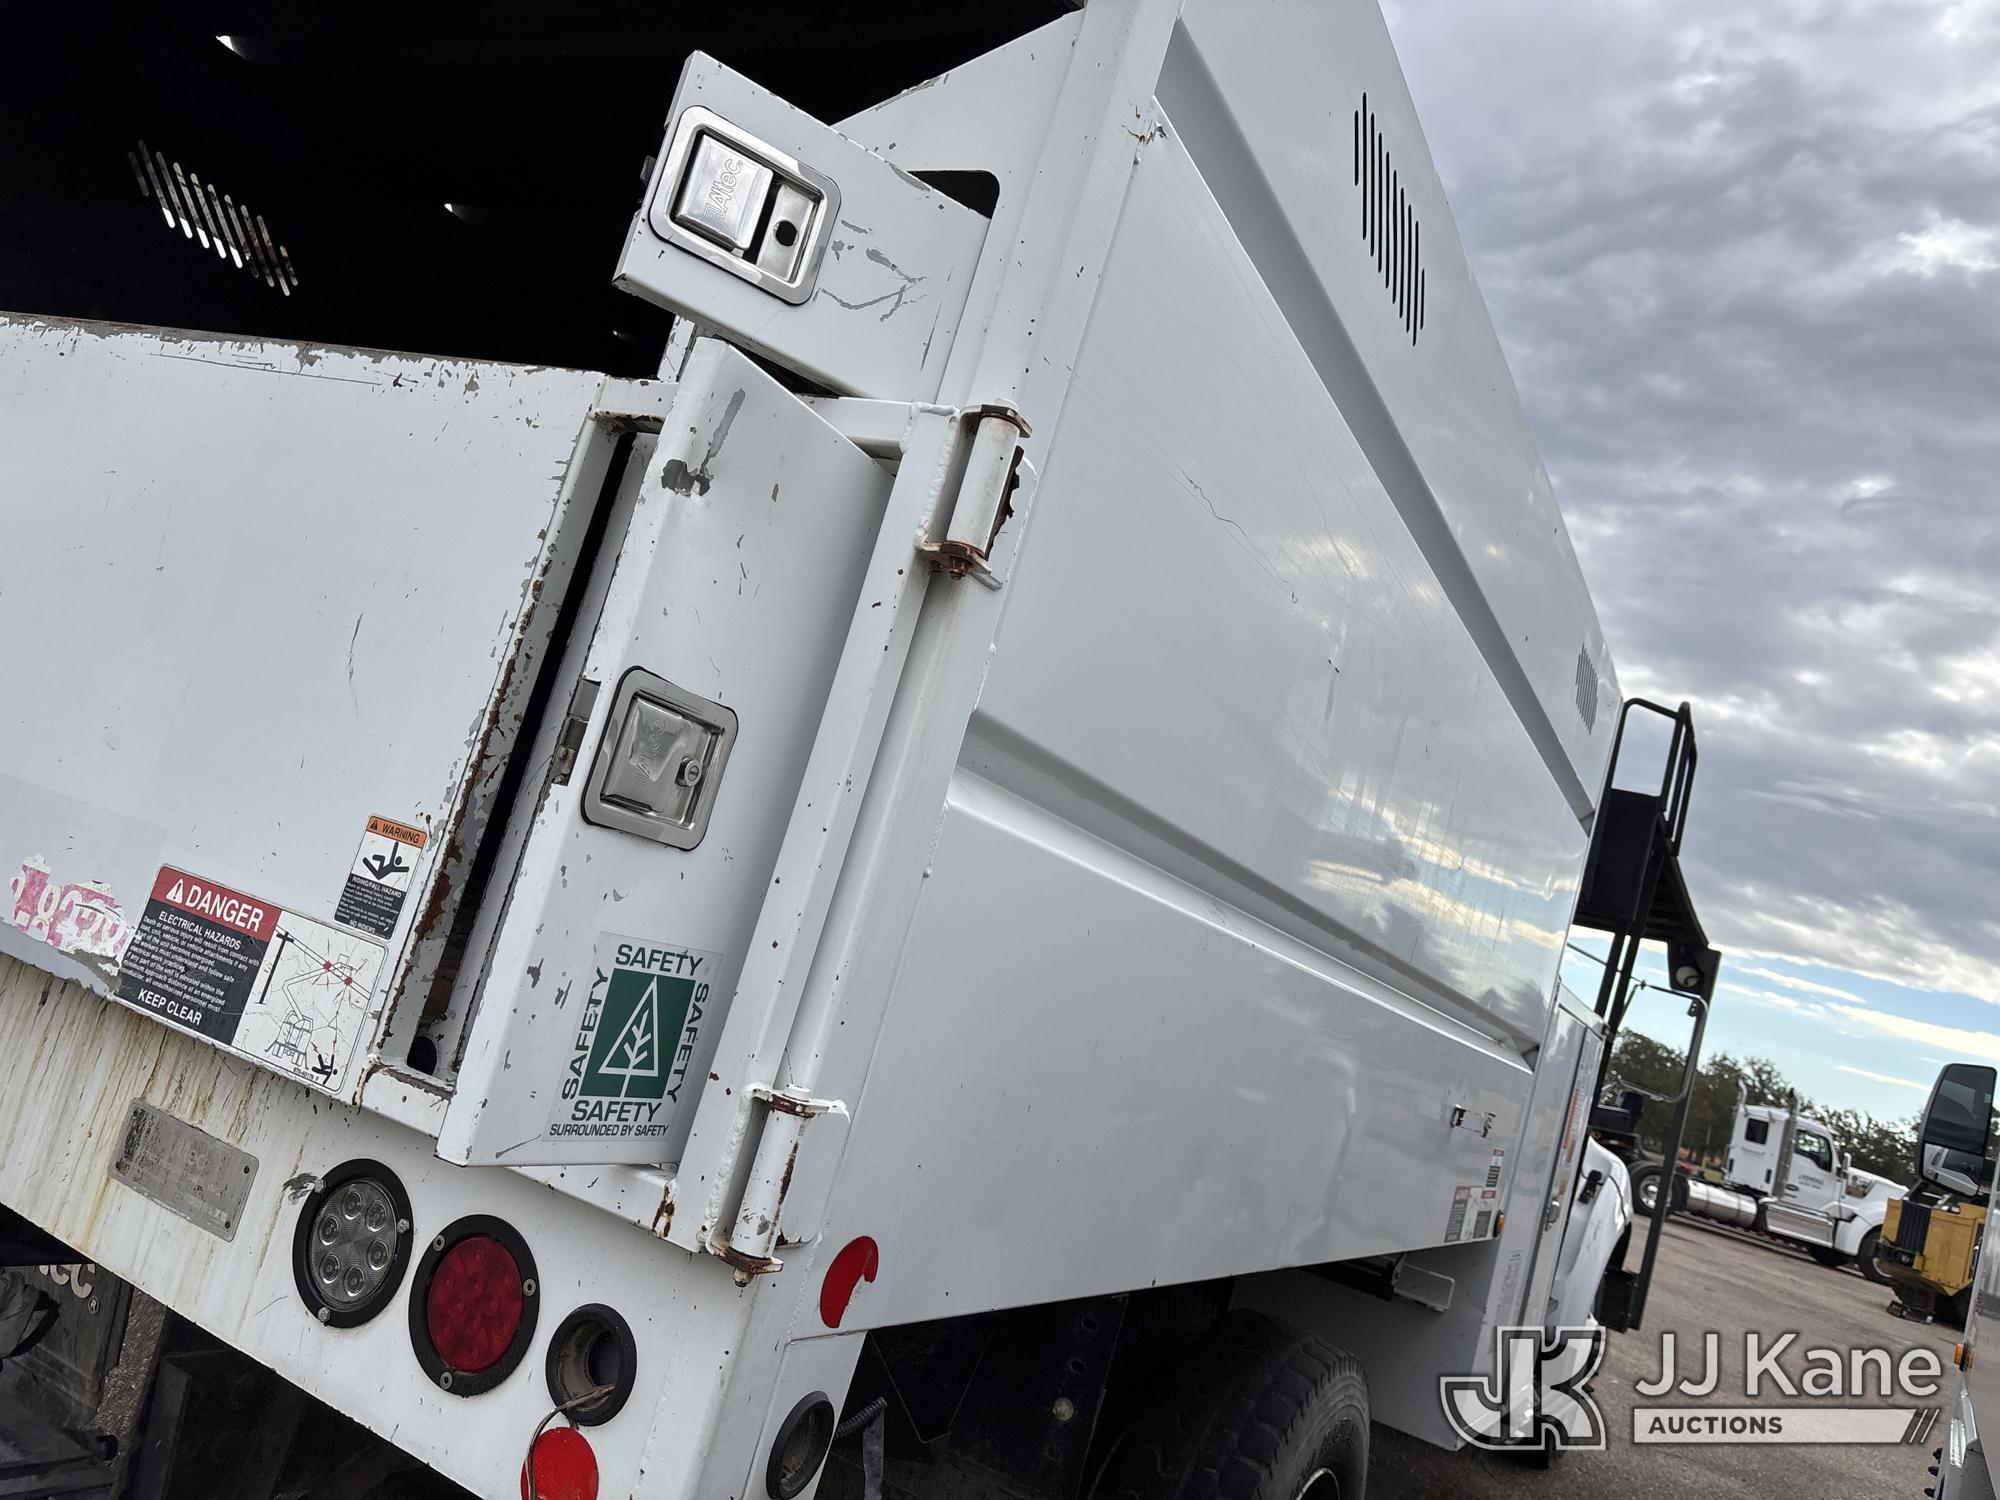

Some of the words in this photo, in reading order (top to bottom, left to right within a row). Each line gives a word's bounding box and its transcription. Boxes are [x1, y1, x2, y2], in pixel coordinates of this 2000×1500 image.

[381, 823, 420, 844] WARNING
[185, 884, 264, 933] DANGER
[381, 886, 401, 898] HAZARD
[158, 910, 204, 936] ELECTRICAL
[203, 928, 241, 950] HAZARDS
[357, 922, 376, 933] RIDERS
[129, 944, 151, 957] electrical
[150, 953, 163, 962] work
[140, 940, 159, 952] workers
[158, 947, 171, 957] must
[171, 952, 198, 968] understand
[197, 963, 208, 972] and
[207, 967, 223, 978] follow
[223, 974, 235, 983] safe
[151, 936, 160, 944] the
[159, 939, 169, 948] unit
[169, 943, 191, 956] becomes
[161, 923, 180, 935] serious
[179, 930, 194, 941] injury
[193, 936, 203, 944] will
[202, 939, 217, 950] result
[216, 945, 229, 955] from
[228, 950, 248, 962] contact
[248, 958, 259, 967] with
[186, 942, 204, 953] vehicle
[203, 949, 233, 965] attachments
[237, 962, 248, 972] any
[616, 944, 703, 976] SAFETY
[129, 953, 139, 962] any
[138, 957, 150, 967] part
[155, 963, 164, 971] the
[163, 967, 174, 976] unit
[179, 973, 200, 986] elevated
[199, 981, 216, 992] within
[215, 987, 224, 996] the
[143, 968, 167, 982] approach
[167, 977, 188, 990] distance
[200, 990, 225, 1006] energized
[137, 988, 167, 1009] KEEP
[165, 1000, 203, 1025] CLEAR
[151, 979, 183, 996] unauthorized
[182, 992, 207, 1007] personnel
[207, 1002, 221, 1012] must
[562, 966, 608, 1100] SAFETY
[667, 982, 709, 1103] SAFETY
[572, 1100, 662, 1122] SAFETY
[549, 1124, 618, 1136] SURROUNDED
[620, 1125, 633, 1136] BY
[635, 1125, 669, 1137] SAFETY
